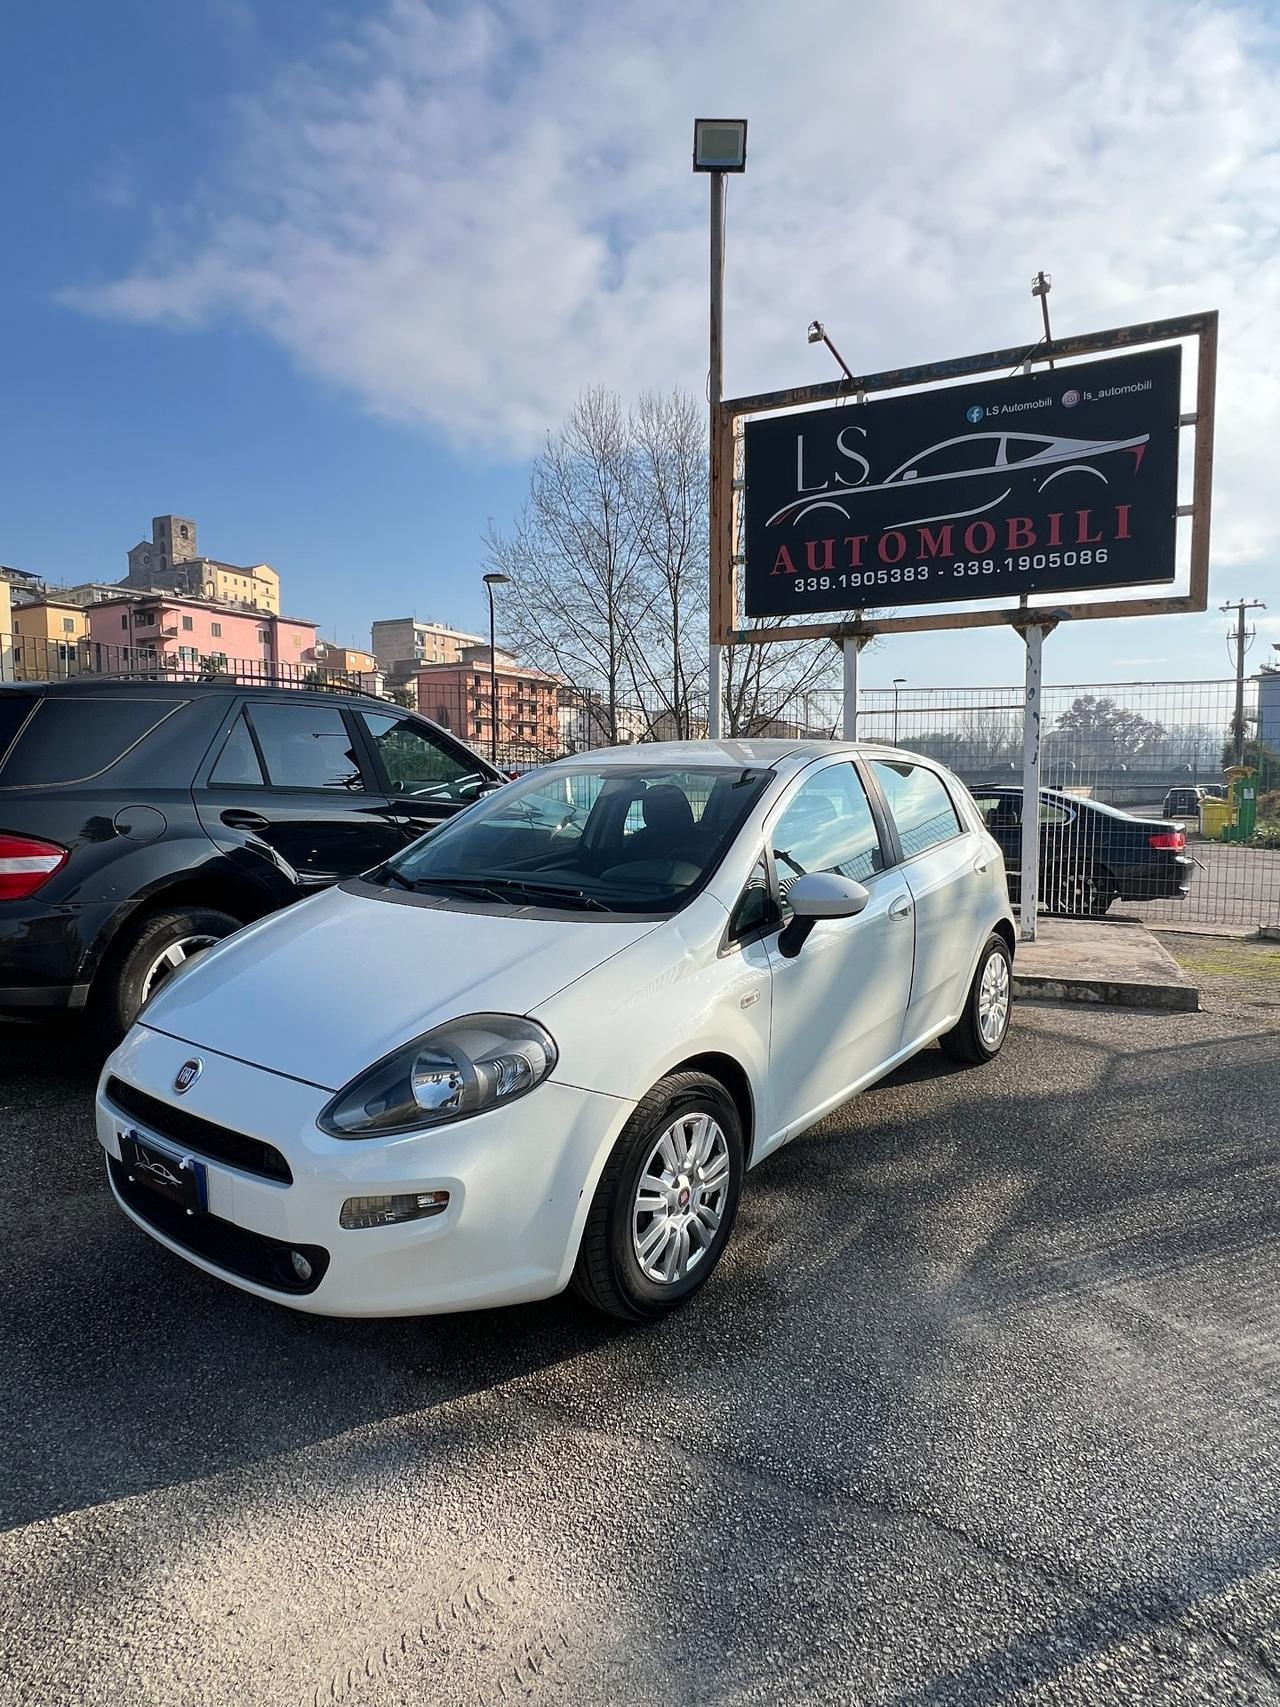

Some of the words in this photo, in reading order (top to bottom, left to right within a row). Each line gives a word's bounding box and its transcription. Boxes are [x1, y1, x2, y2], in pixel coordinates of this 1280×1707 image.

[986, 405, 1000, 416] LS
[1001, 397, 1052, 413] Automobili
[769, 504, 1132, 576] AUTOMOBILI
[794, 566, 929, 592] 339.1905383
[953, 549, 1108, 577] 339.1905086
[178, 1066, 196, 1084] FIAT
